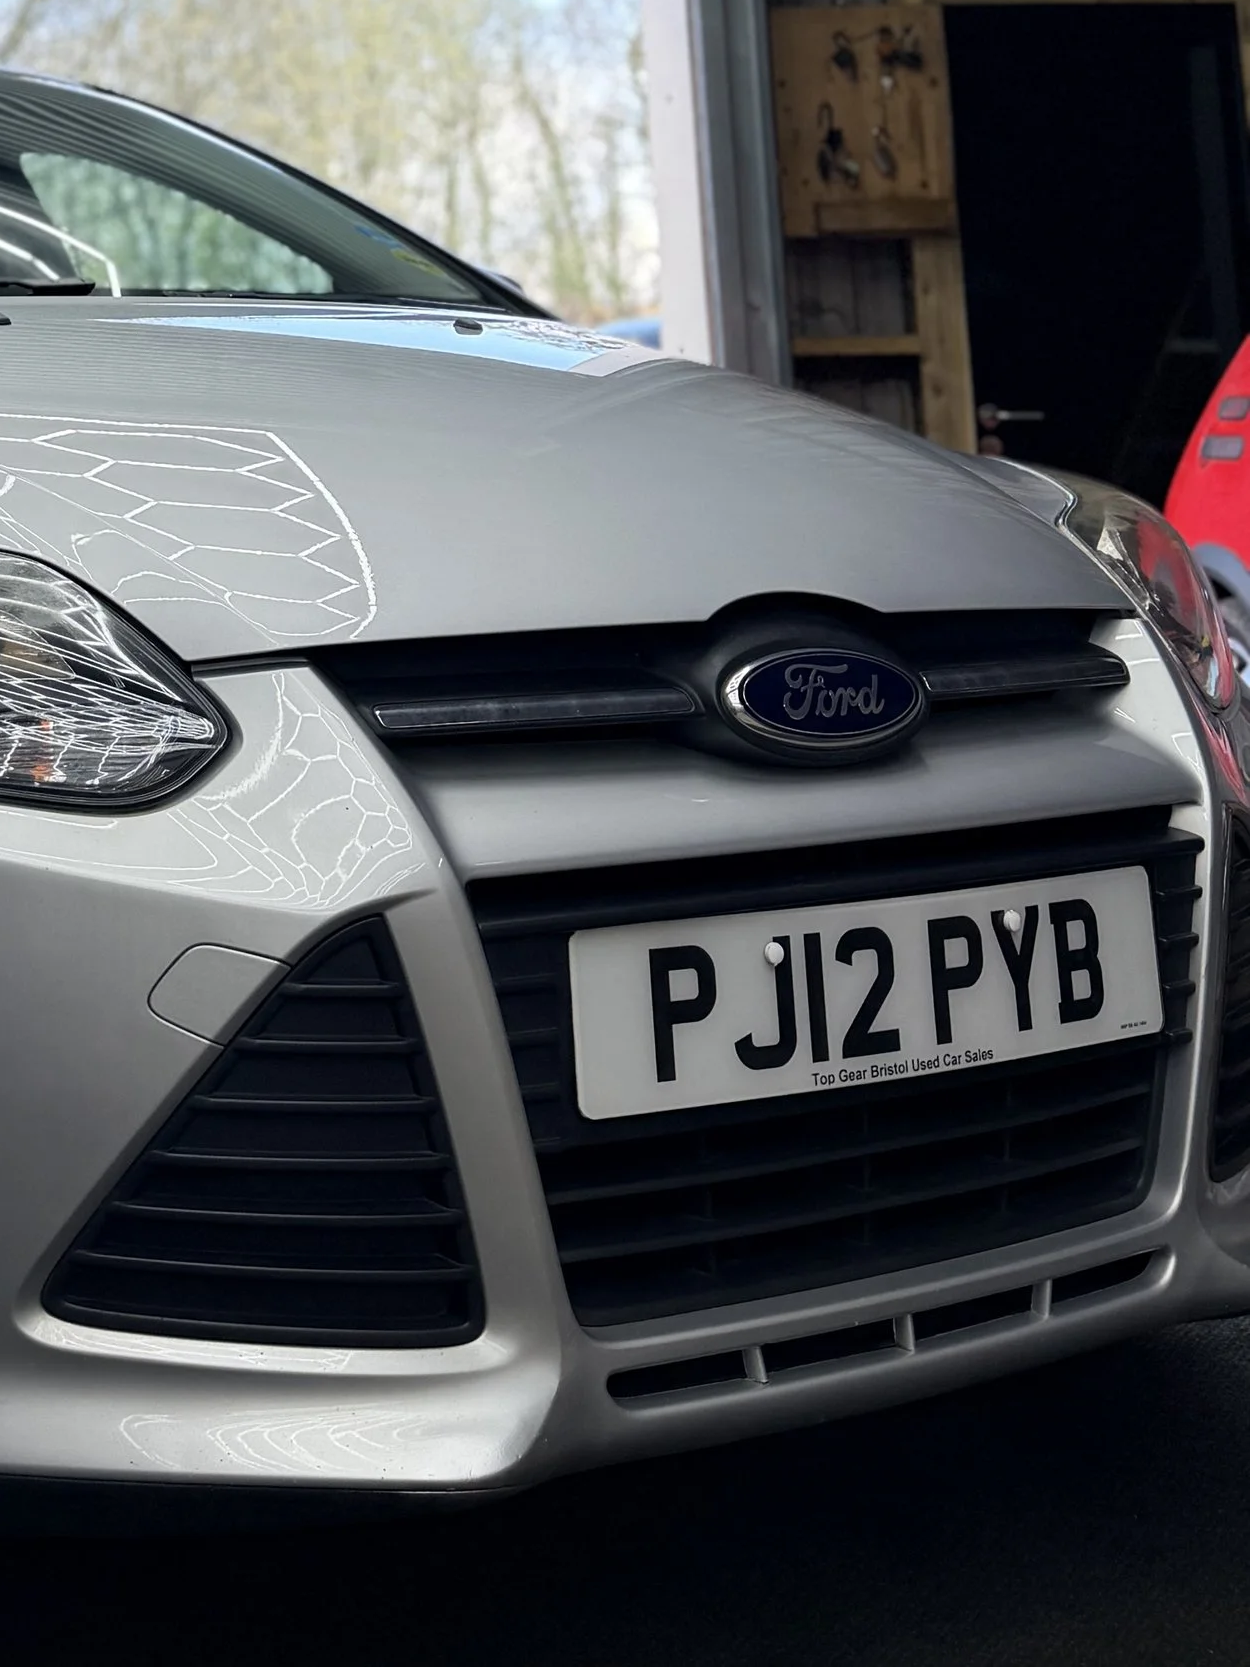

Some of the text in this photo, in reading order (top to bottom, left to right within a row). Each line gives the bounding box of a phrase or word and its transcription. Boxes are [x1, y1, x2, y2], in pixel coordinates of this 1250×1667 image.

[783, 663, 885, 720] Ford
[649, 898, 1105, 1083] PJ12 PYB
[812, 1048, 994, 1086] Top Gear Bristol Used Car Sales
